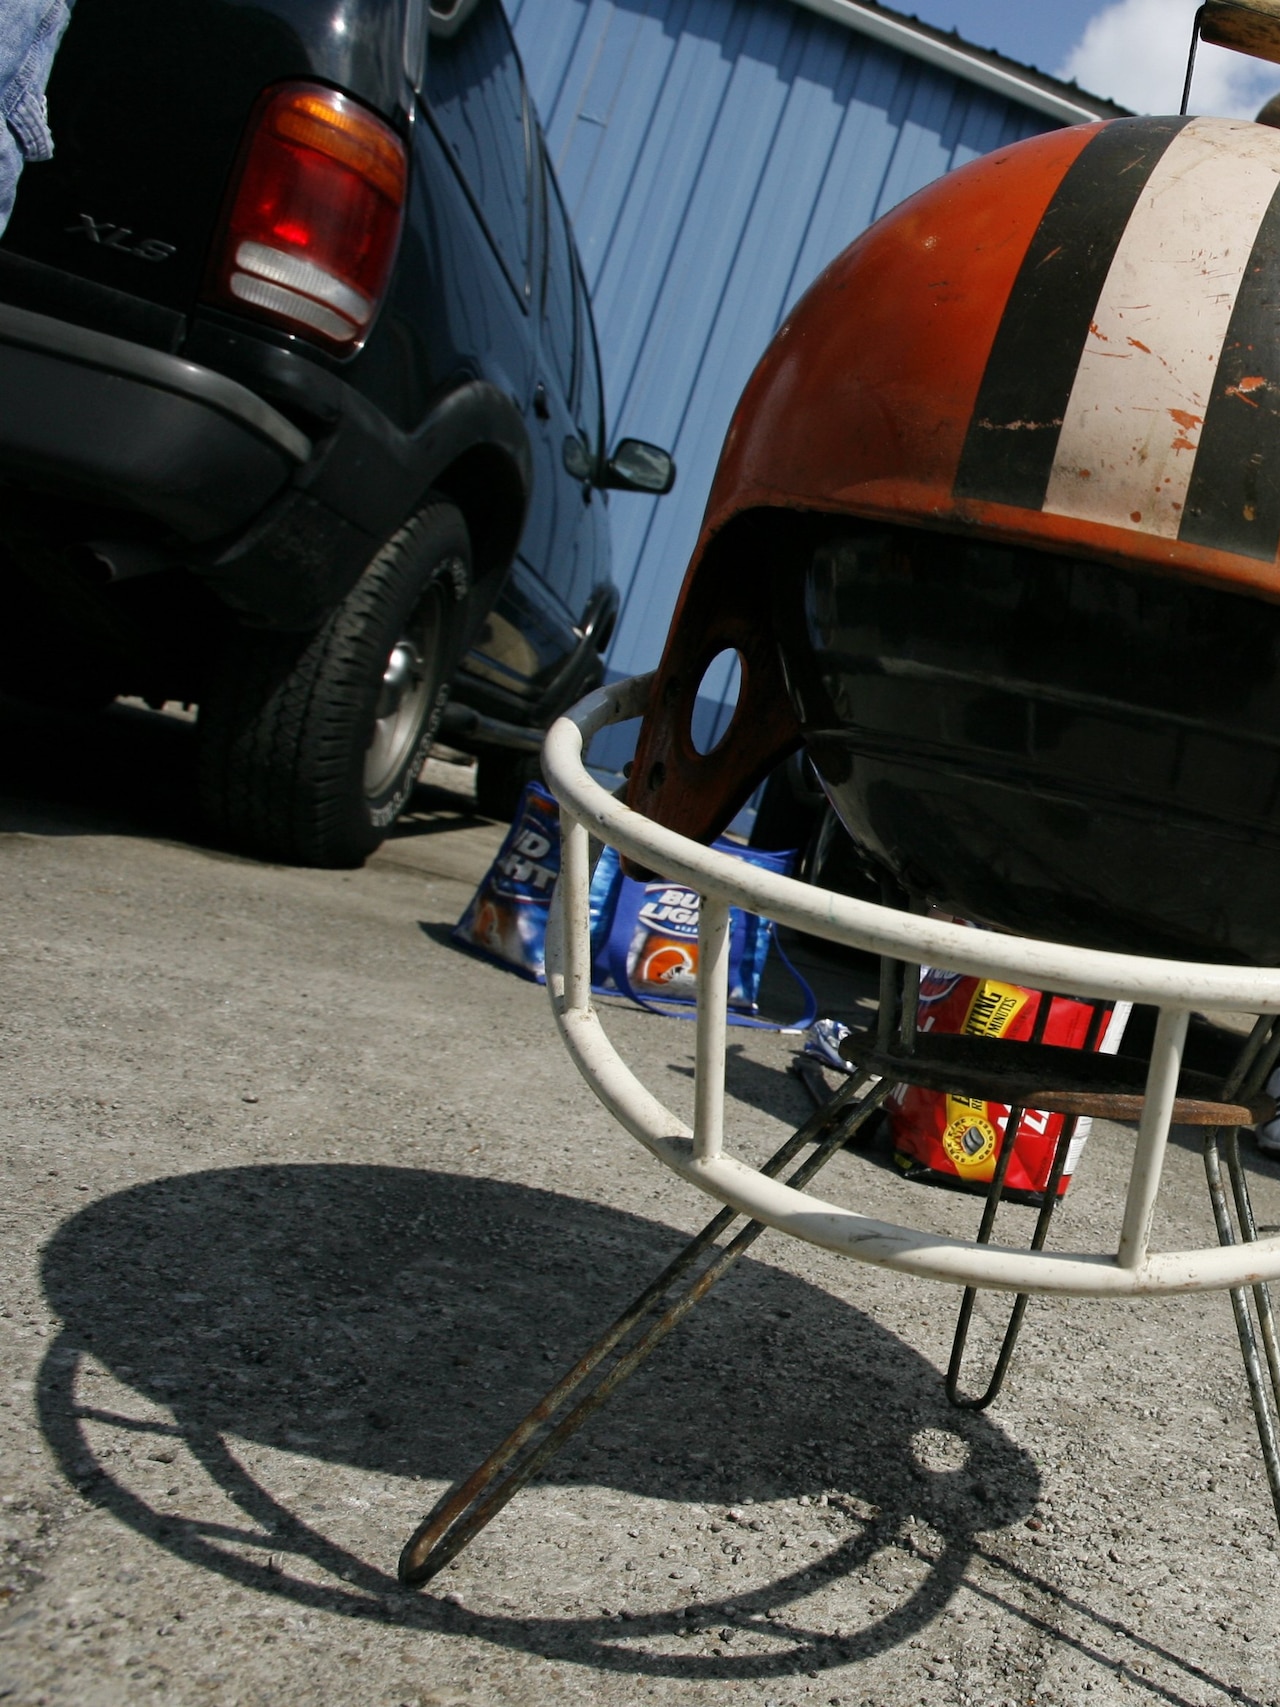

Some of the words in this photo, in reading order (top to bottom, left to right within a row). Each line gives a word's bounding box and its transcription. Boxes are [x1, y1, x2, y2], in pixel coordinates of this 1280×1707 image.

[64, 212, 176, 261] XLS
[658, 889, 700, 910] BU
[988, 996, 1018, 1034] MINUTES
[978, 1120, 994, 1161] GROOVES
